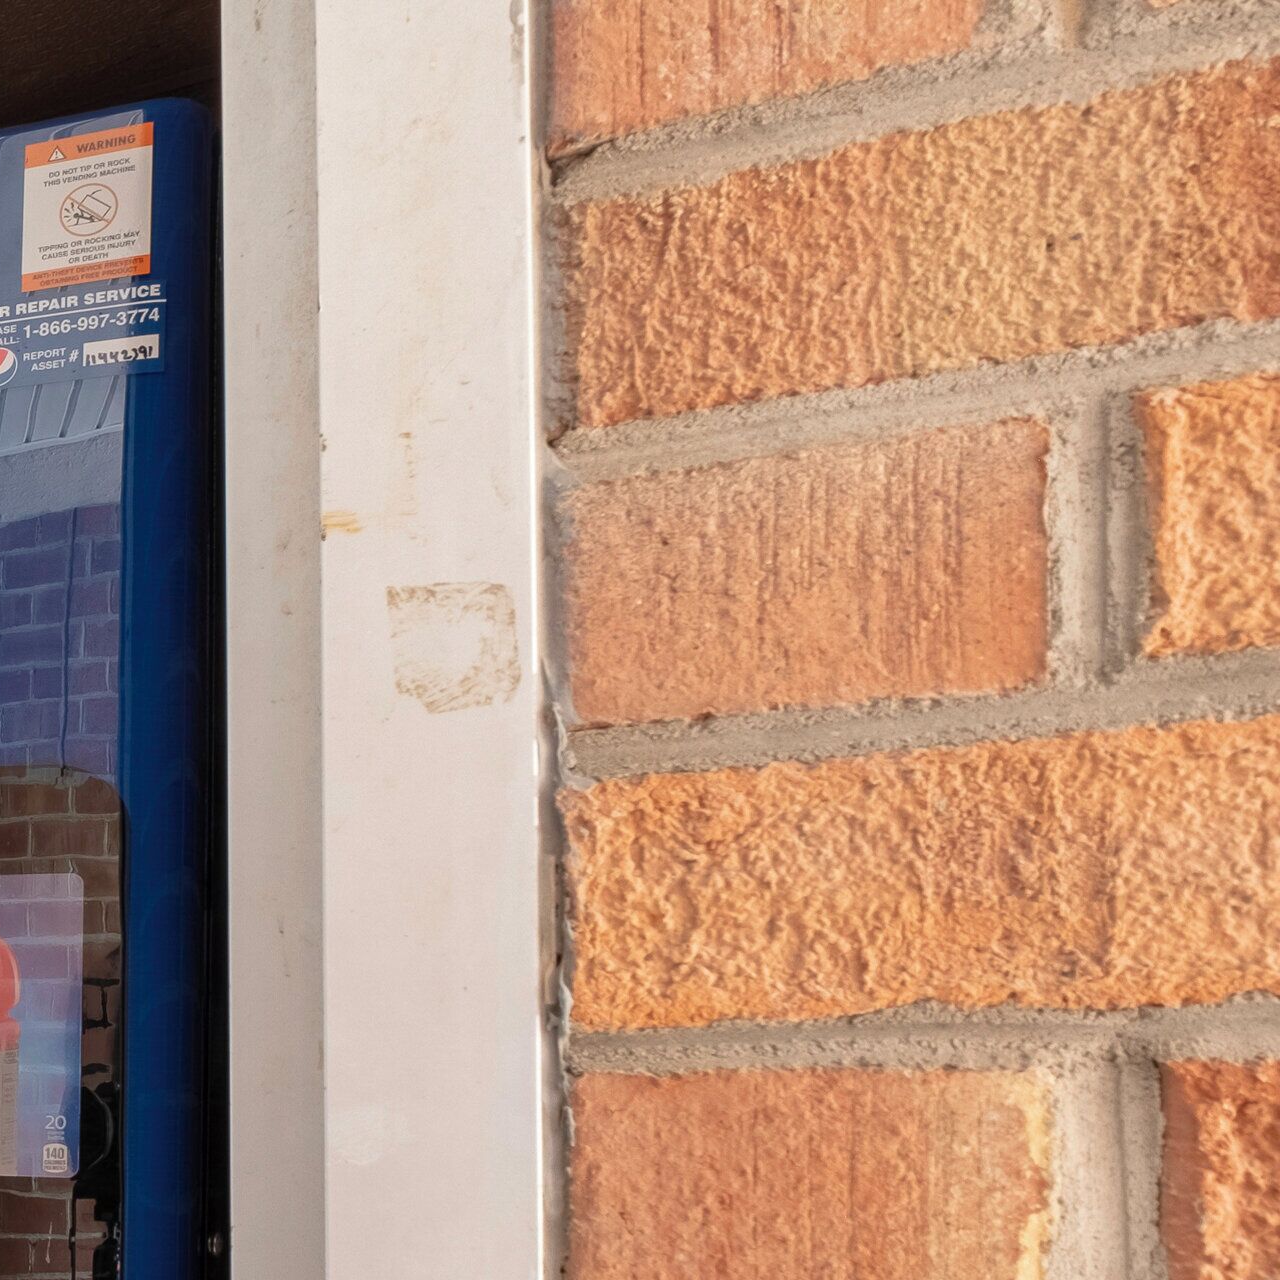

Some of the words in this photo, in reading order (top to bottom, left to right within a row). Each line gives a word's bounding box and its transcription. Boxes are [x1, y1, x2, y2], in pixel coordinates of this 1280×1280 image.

[76, 134, 136, 153] WARNING
[43, 178, 61, 187] THIS
[62, 172, 98, 184] VENDING
[100, 165, 136, 177] MACHINE
[48, 171, 60, 179] DO
[62, 167, 78, 176] NOT
[80, 164, 92, 173] TIP
[94, 161, 106, 170] OR
[107, 158, 131, 168] ROCK
[38, 243, 69, 253] TIPPING
[71, 240, 83, 248] OR
[84, 233, 121, 246] ROCKING
[42, 251, 69, 260] CAUSE
[70, 244, 106, 256] SERIOUS
[107, 239, 136, 249] INJURY
[82, 252, 109, 262] DEATH
[15, 295, 79, 316] REPAIR
[84, 284, 161, 304] SERVICE
[23, 308, 160, 339] 1-866-997-3774
[23, 347, 66, 361] REPORT
[31, 359, 66, 372] ASSET
[45, 1115, 67, 1130] 20
[45, 1147, 65, 1160] 140
